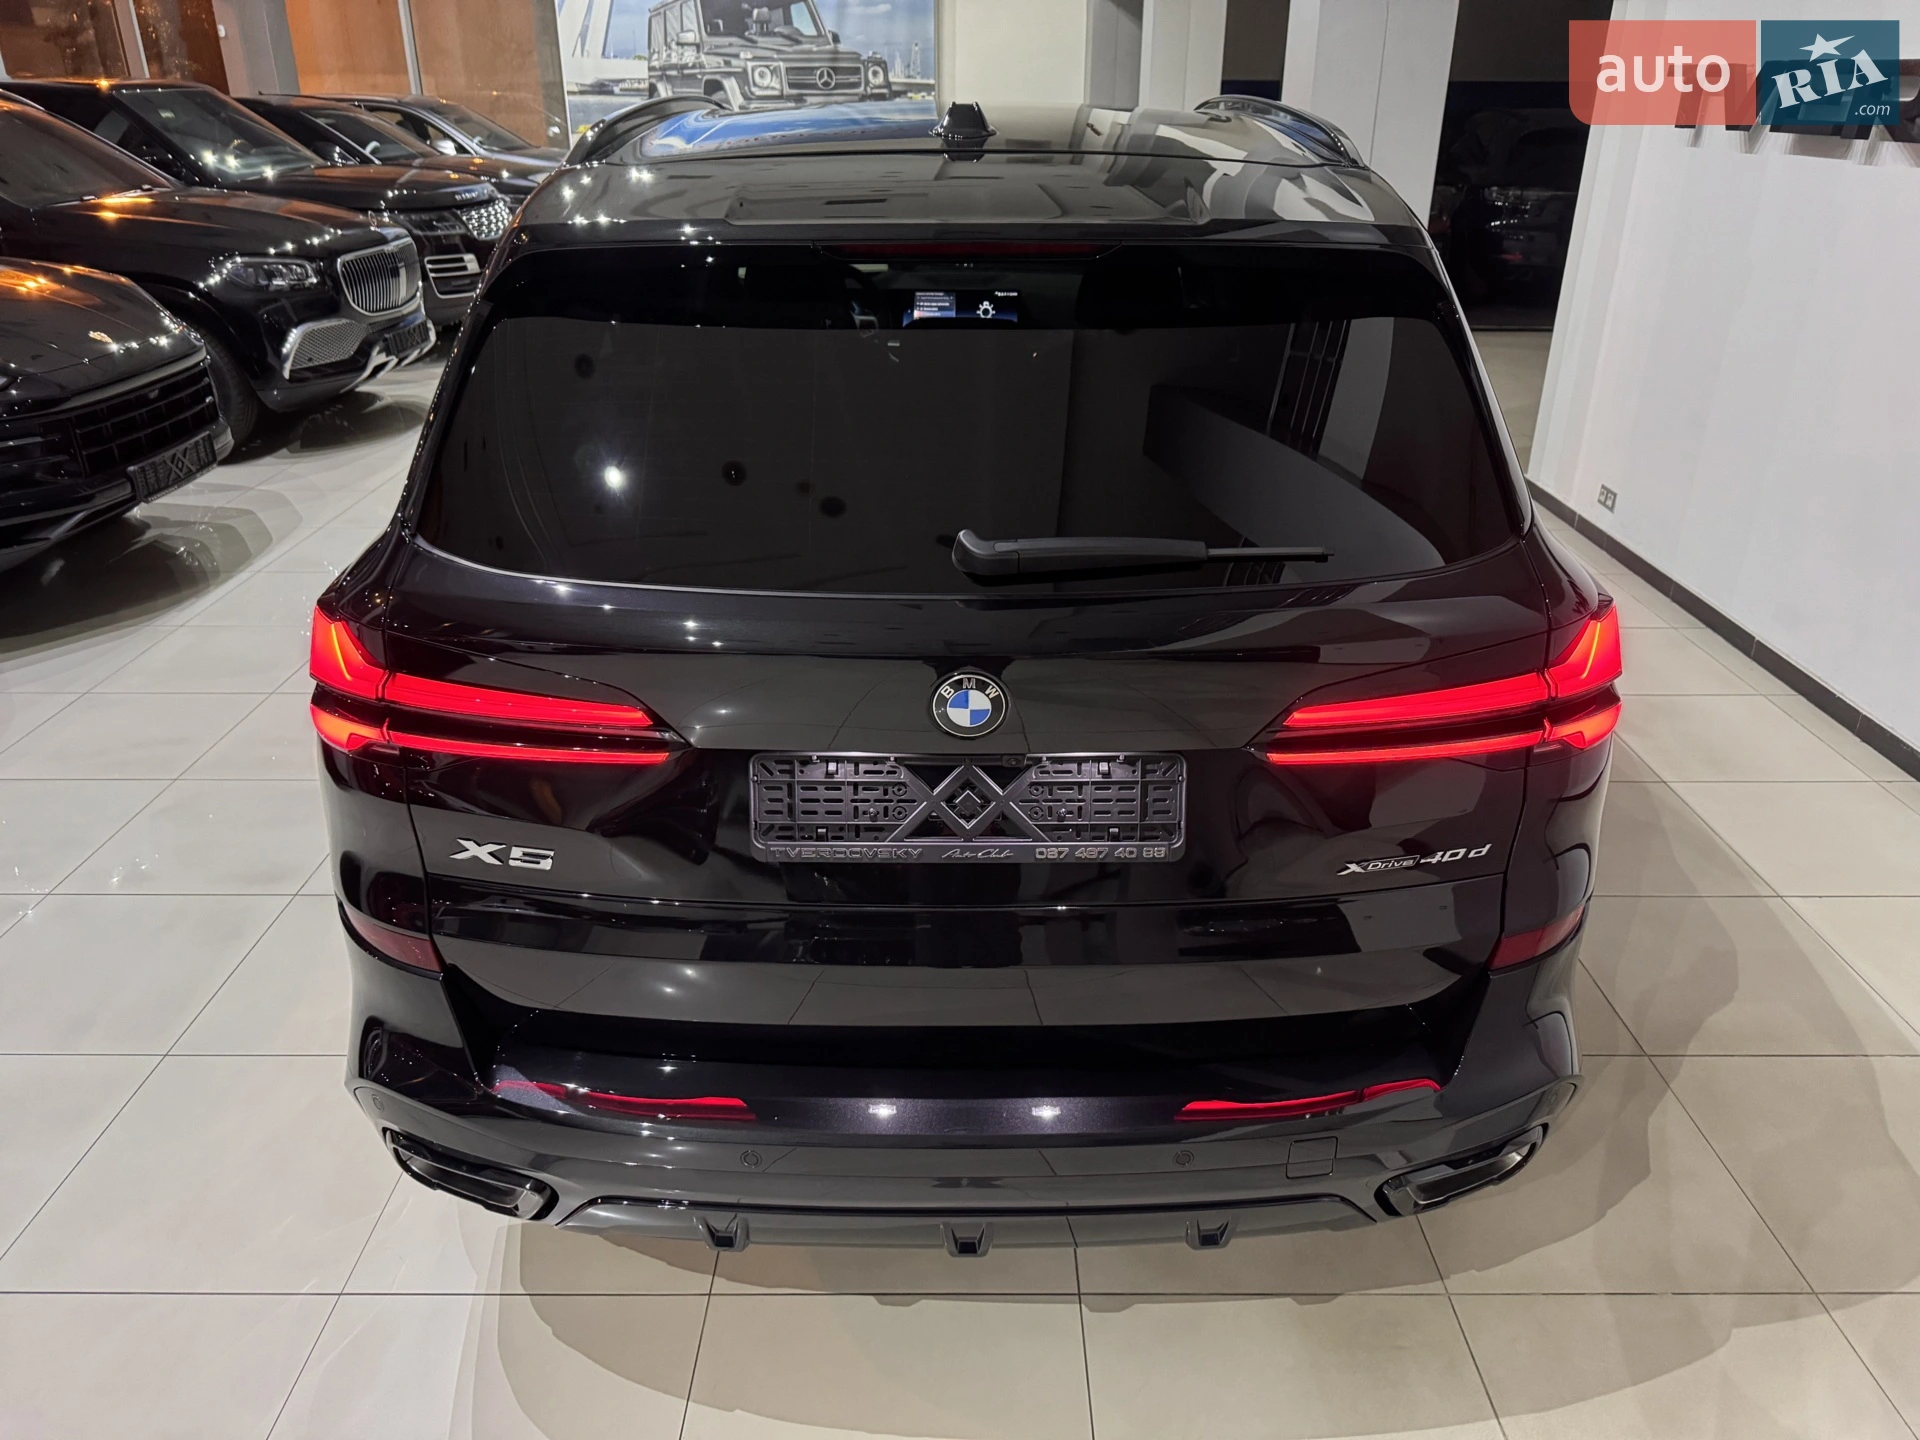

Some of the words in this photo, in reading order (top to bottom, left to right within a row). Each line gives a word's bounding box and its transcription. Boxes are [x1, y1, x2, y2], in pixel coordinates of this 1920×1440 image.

[941, 677, 1000, 699] BMW
[448, 837, 555, 871] X5
[770, 847, 923, 860] TVERDOVSKY
[1114, 847, 1138, 859] 40
